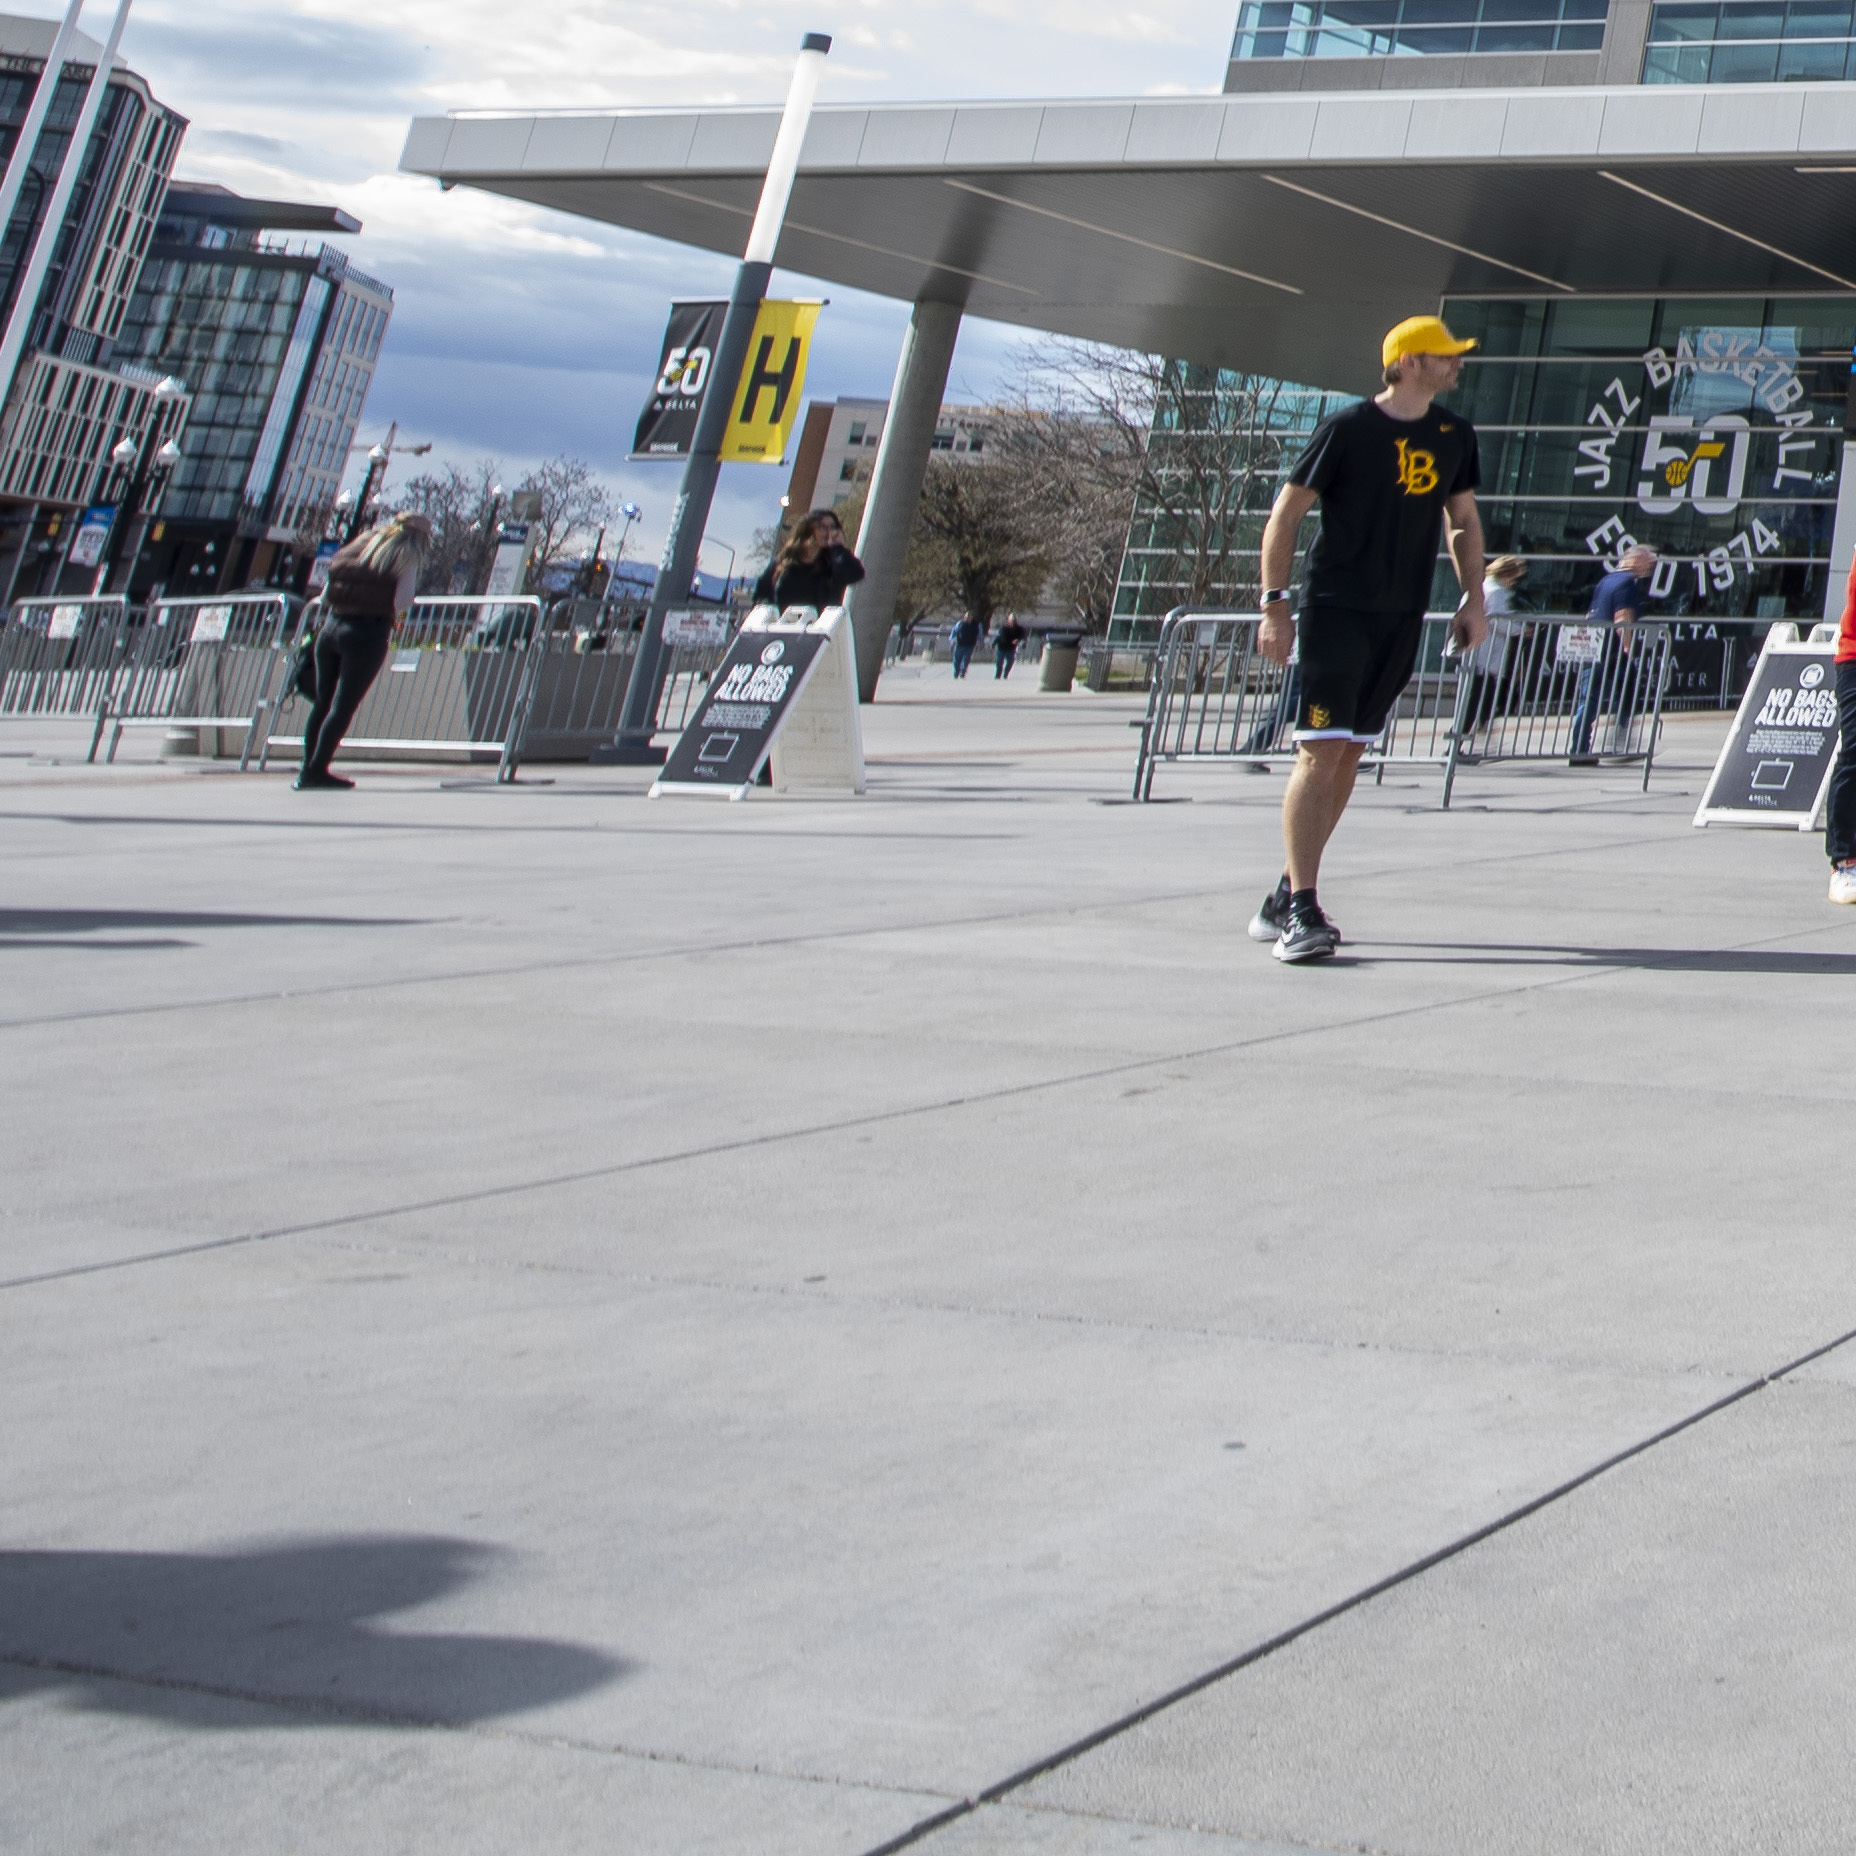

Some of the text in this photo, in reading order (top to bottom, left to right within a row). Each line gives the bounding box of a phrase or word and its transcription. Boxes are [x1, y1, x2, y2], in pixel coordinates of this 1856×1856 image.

[657, 346, 711, 395] 50
[739, 334, 802, 424] H
[1574, 332, 1816, 490] JAZZ BASKETBALL
[1395, 437, 1440, 496] LB
[1636, 415, 1751, 515] 50
[1692, 517, 1781, 597] 1974
[713, 682, 788, 704] ALLOWED
[726, 663, 794, 684] NO BAGS
[1765, 687, 1838, 710] NO BAGS
[1754, 706, 1837, 728] ALLOWED
